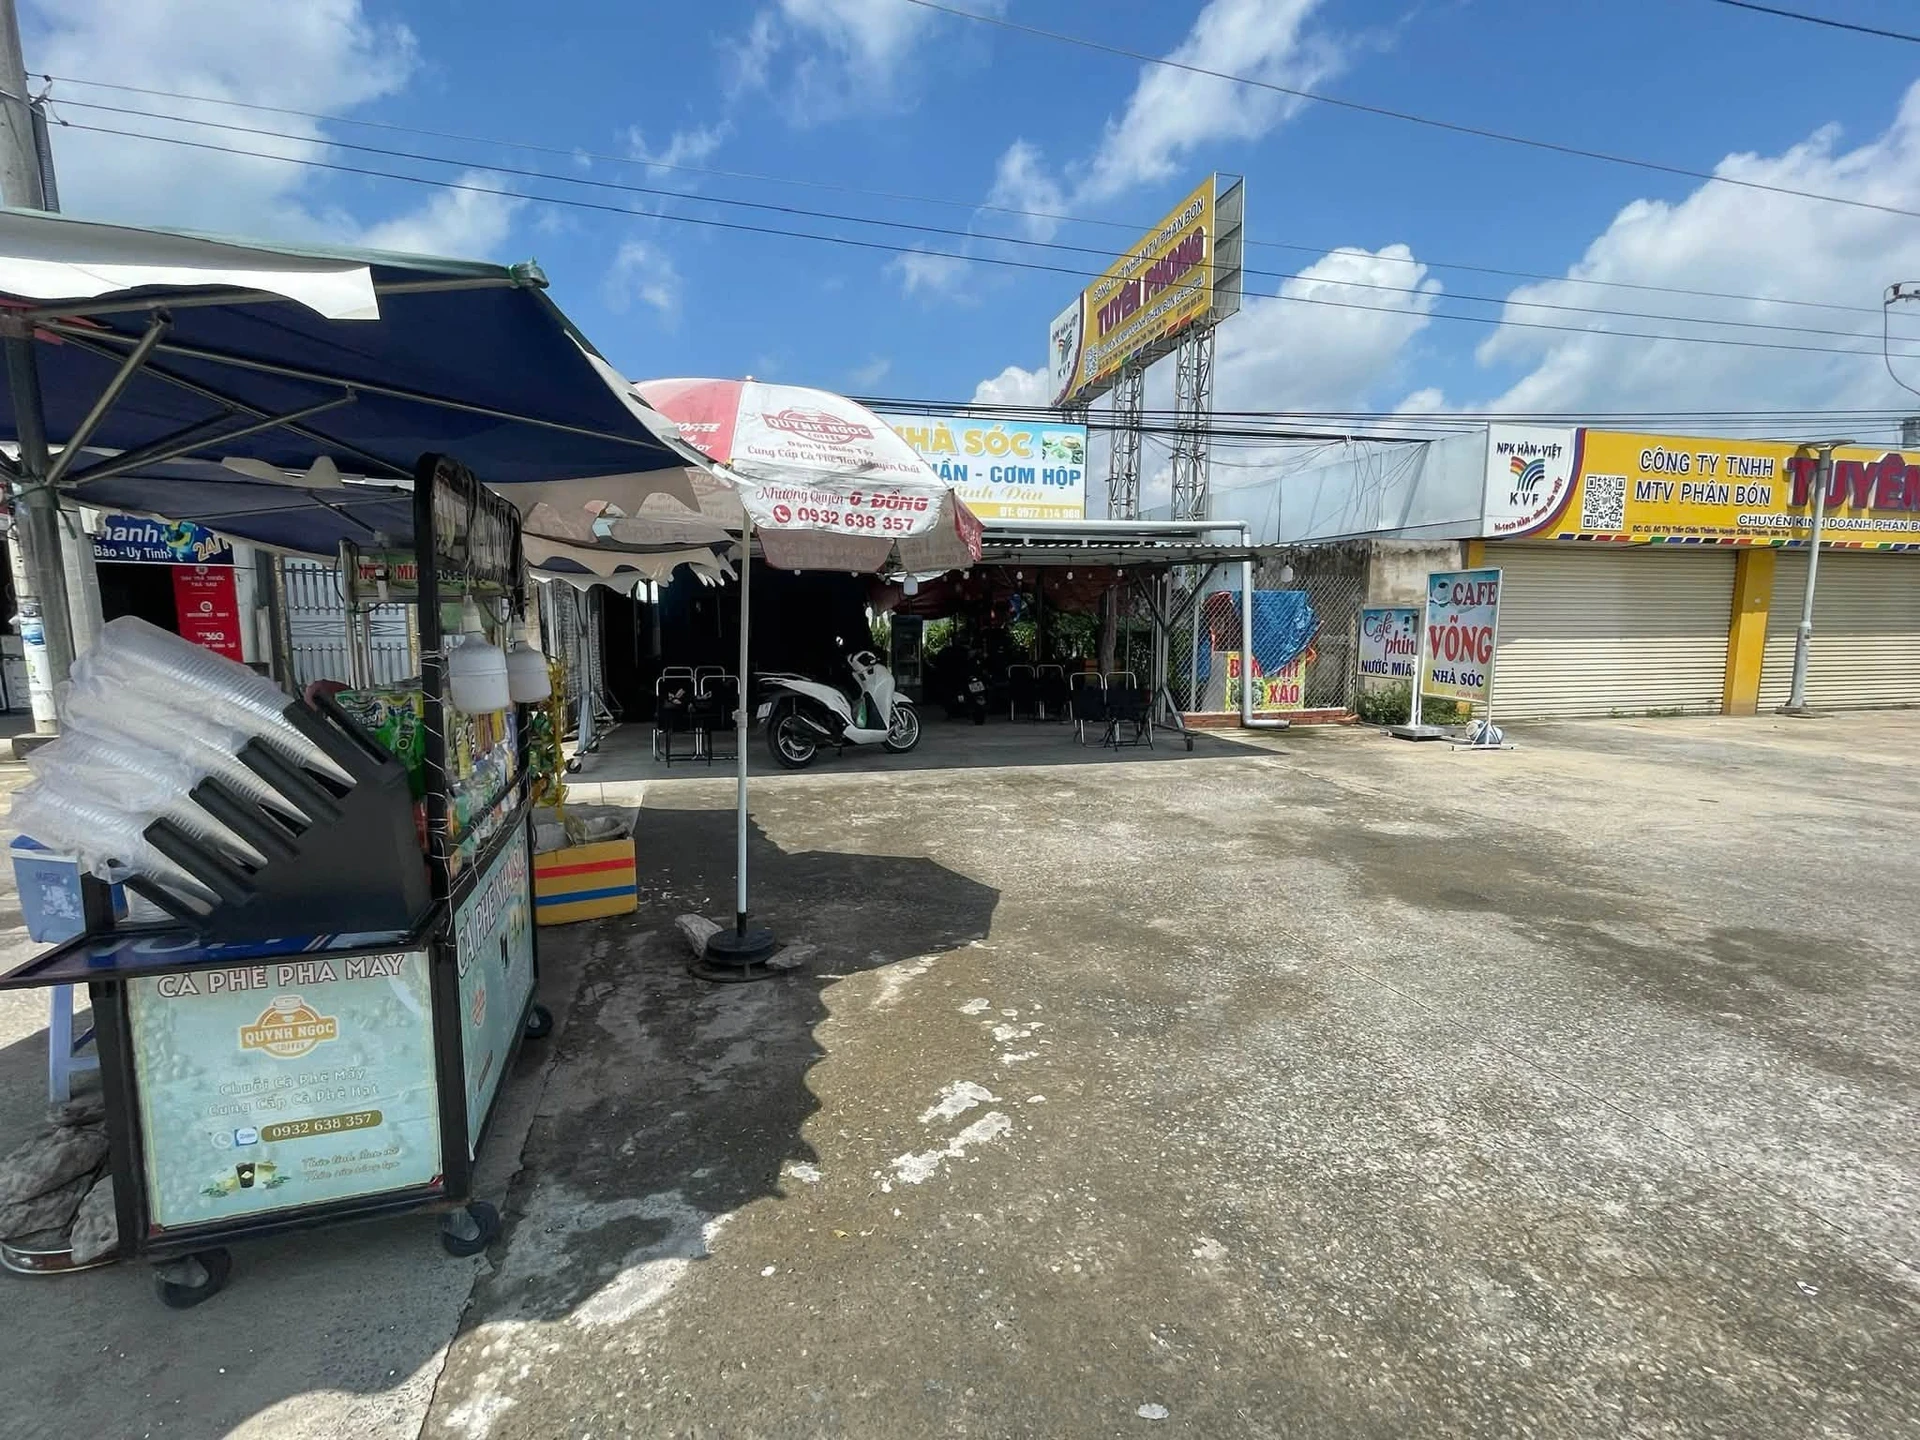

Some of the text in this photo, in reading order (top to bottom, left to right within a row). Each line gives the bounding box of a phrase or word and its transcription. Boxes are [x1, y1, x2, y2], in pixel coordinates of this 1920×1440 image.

[1097, 265, 1143, 338] TUYÊN
[747, 445, 775, 458] Cung
[778, 446, 798, 461] Cấp
[965, 424, 1032, 457] SÓC
[1496, 442, 1515, 455] NPK
[932, 457, 968, 482] ẦN
[990, 465, 1038, 484] CƠM
[1042, 466, 1082, 490] HỘP
[1640, 447, 1774, 477] CÔNG TY TNHH
[756, 486, 808, 505] Nhượng
[870, 488, 929, 511] ĐỒNG
[1636, 480, 1771, 506] MTV PHÂN BÓN
[798, 507, 914, 532] 0932 638 357
[1738, 513, 1792, 527] CHUYÊN
[1829, 517, 1872, 529] DOANH
[1875, 518, 1908, 530] PHÂN
[97, 524, 157, 543] anh
[126, 546, 141, 560] Uy
[1453, 581, 1497, 606] CAFE
[1384, 630, 1417, 661] phin
[1429, 615, 1493, 665] VÕNG
[1229, 658, 1264, 678] BN
[1361, 659, 1412, 677] NƯỚC MÍA
[1432, 668, 1484, 688] NHÀ SÓC
[157, 972, 200, 998] CÀ
[208, 964, 268, 994] PHÊ
[278, 959, 337, 987] PHA
[208, 1101, 251, 1117] Cung
[272, 1122, 310, 1138] 0932
[314, 1117, 341, 1131] 638
[346, 1113, 372, 1127] 357
